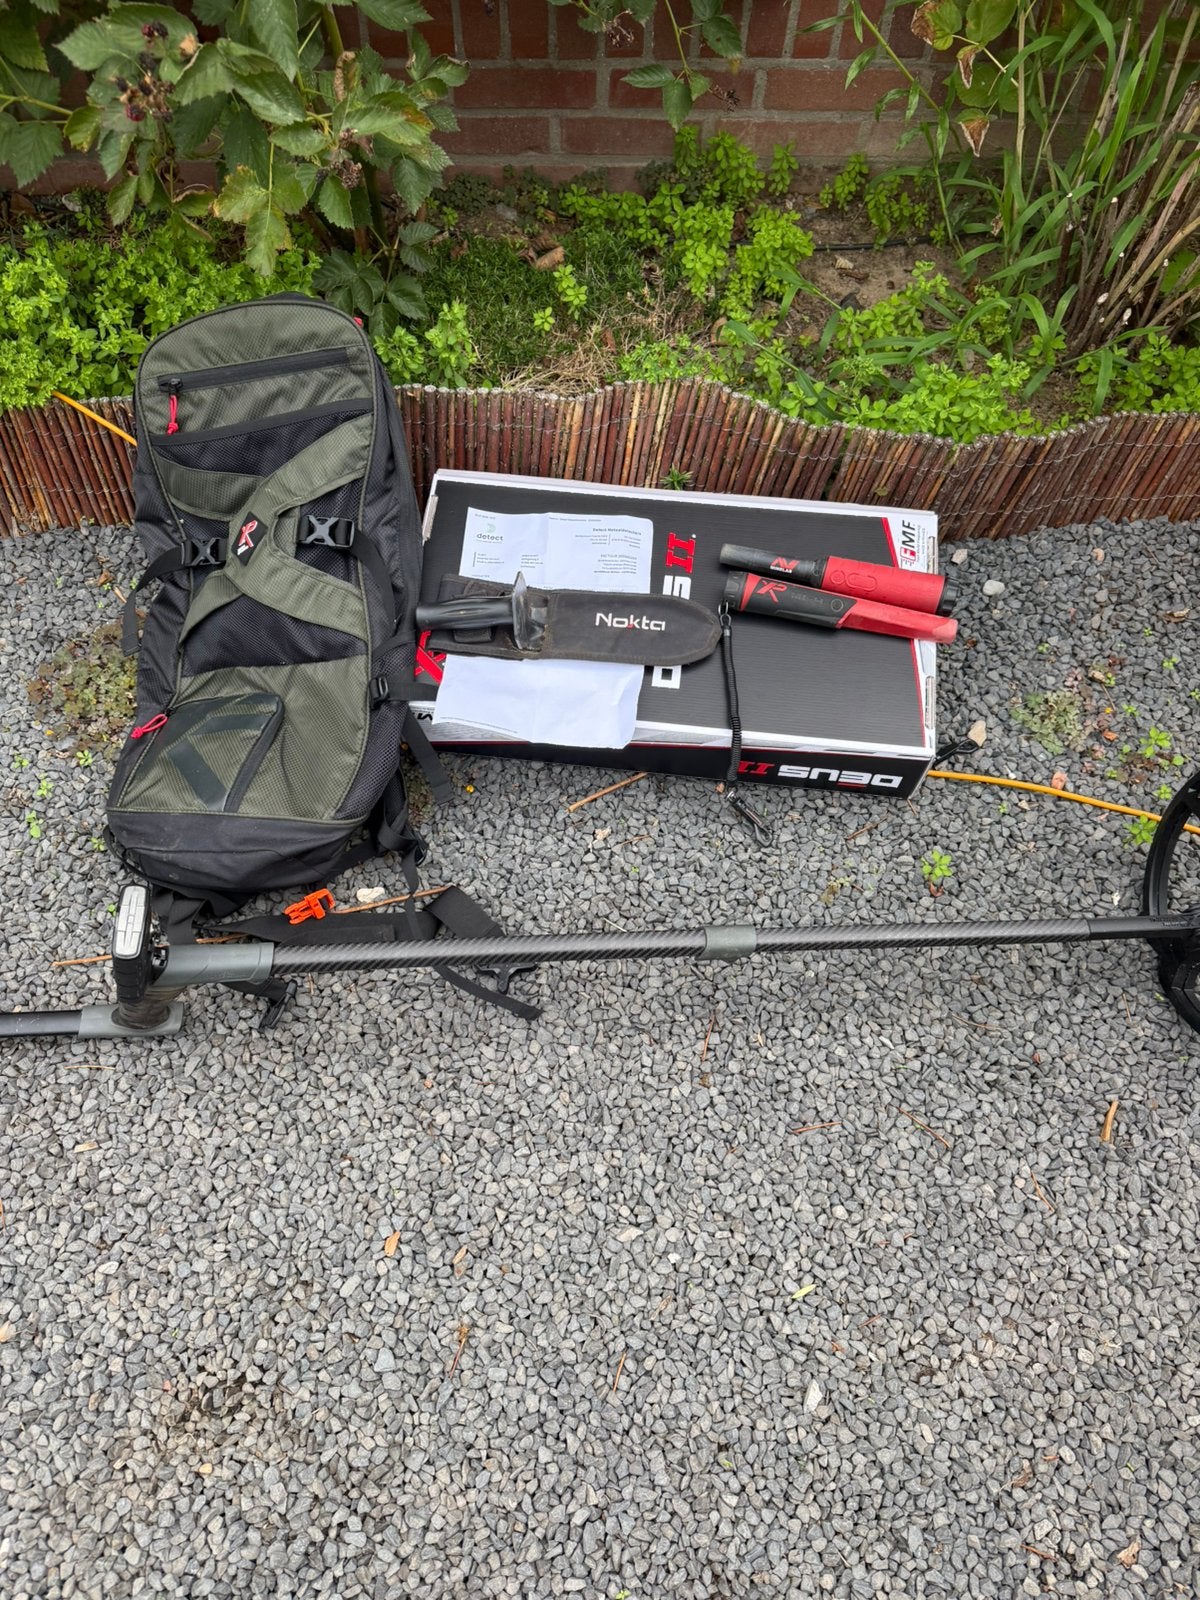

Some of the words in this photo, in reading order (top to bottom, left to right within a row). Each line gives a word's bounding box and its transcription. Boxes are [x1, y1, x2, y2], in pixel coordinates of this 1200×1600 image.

[476, 533, 504, 541] detect
[595, 612, 666, 632] Nokta
[777, 764, 904, 789] DEUS
